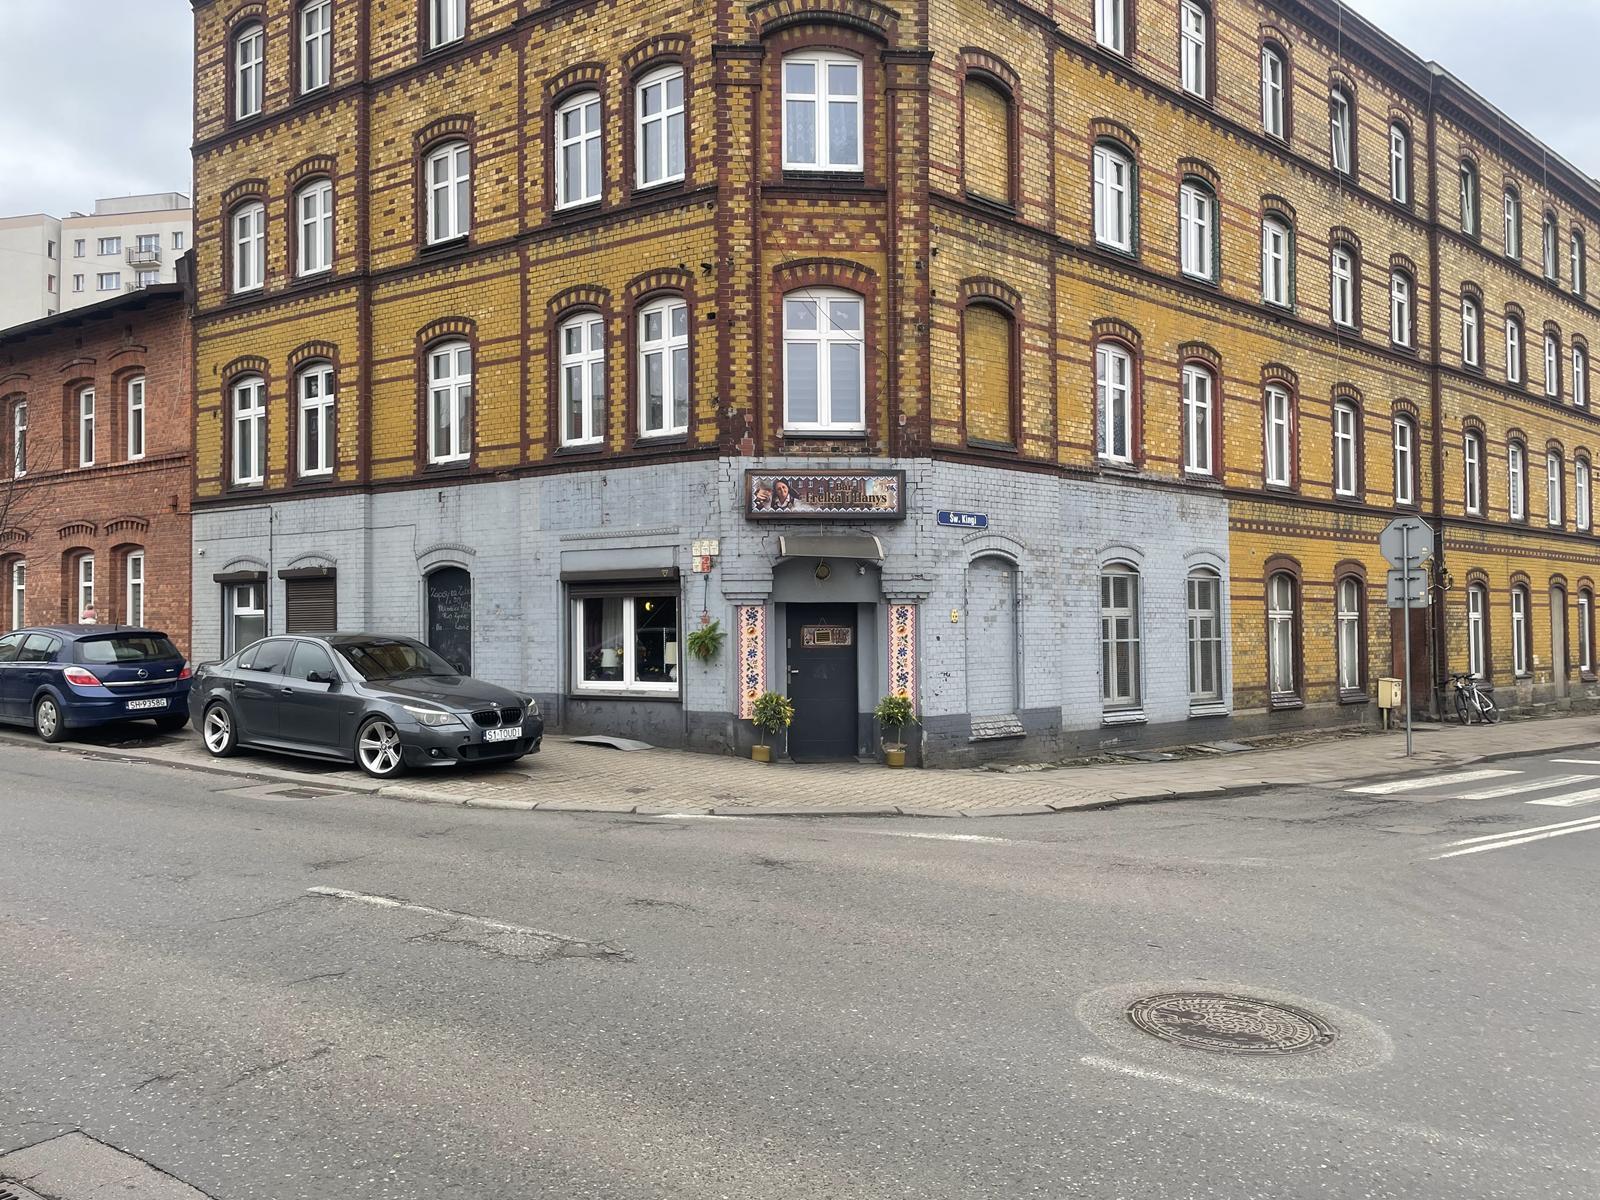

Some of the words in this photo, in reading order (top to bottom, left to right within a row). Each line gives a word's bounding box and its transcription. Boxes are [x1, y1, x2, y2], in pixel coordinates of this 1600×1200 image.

[835, 483, 852, 491] Bar
[806, 492, 842, 503] Frelka
[853, 492, 887, 505] Hanys
[961, 514, 977, 526] Kingi
